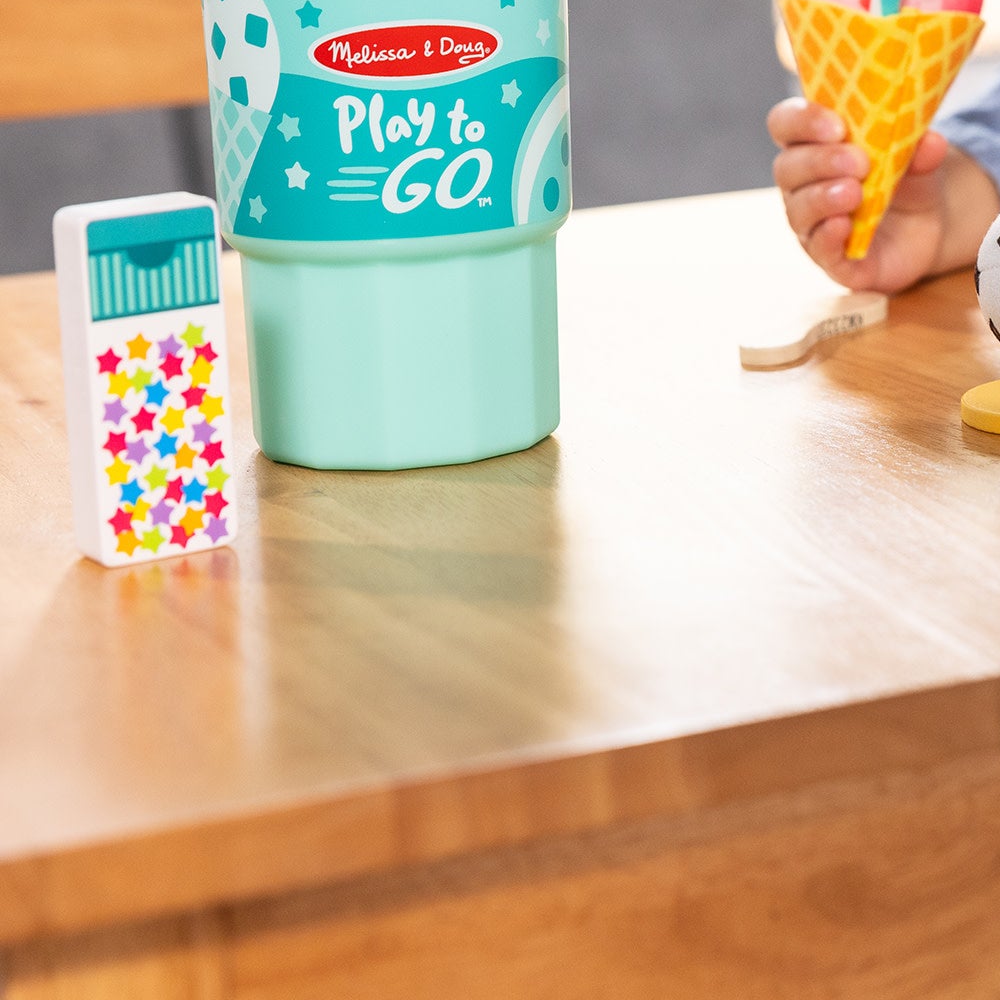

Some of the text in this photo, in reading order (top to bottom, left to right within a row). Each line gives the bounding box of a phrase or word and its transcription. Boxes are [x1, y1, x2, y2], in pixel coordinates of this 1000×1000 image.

[327, 40, 417, 68] Melissa
[423, 39, 435, 58] &
[332, 92, 486, 155] Play to
